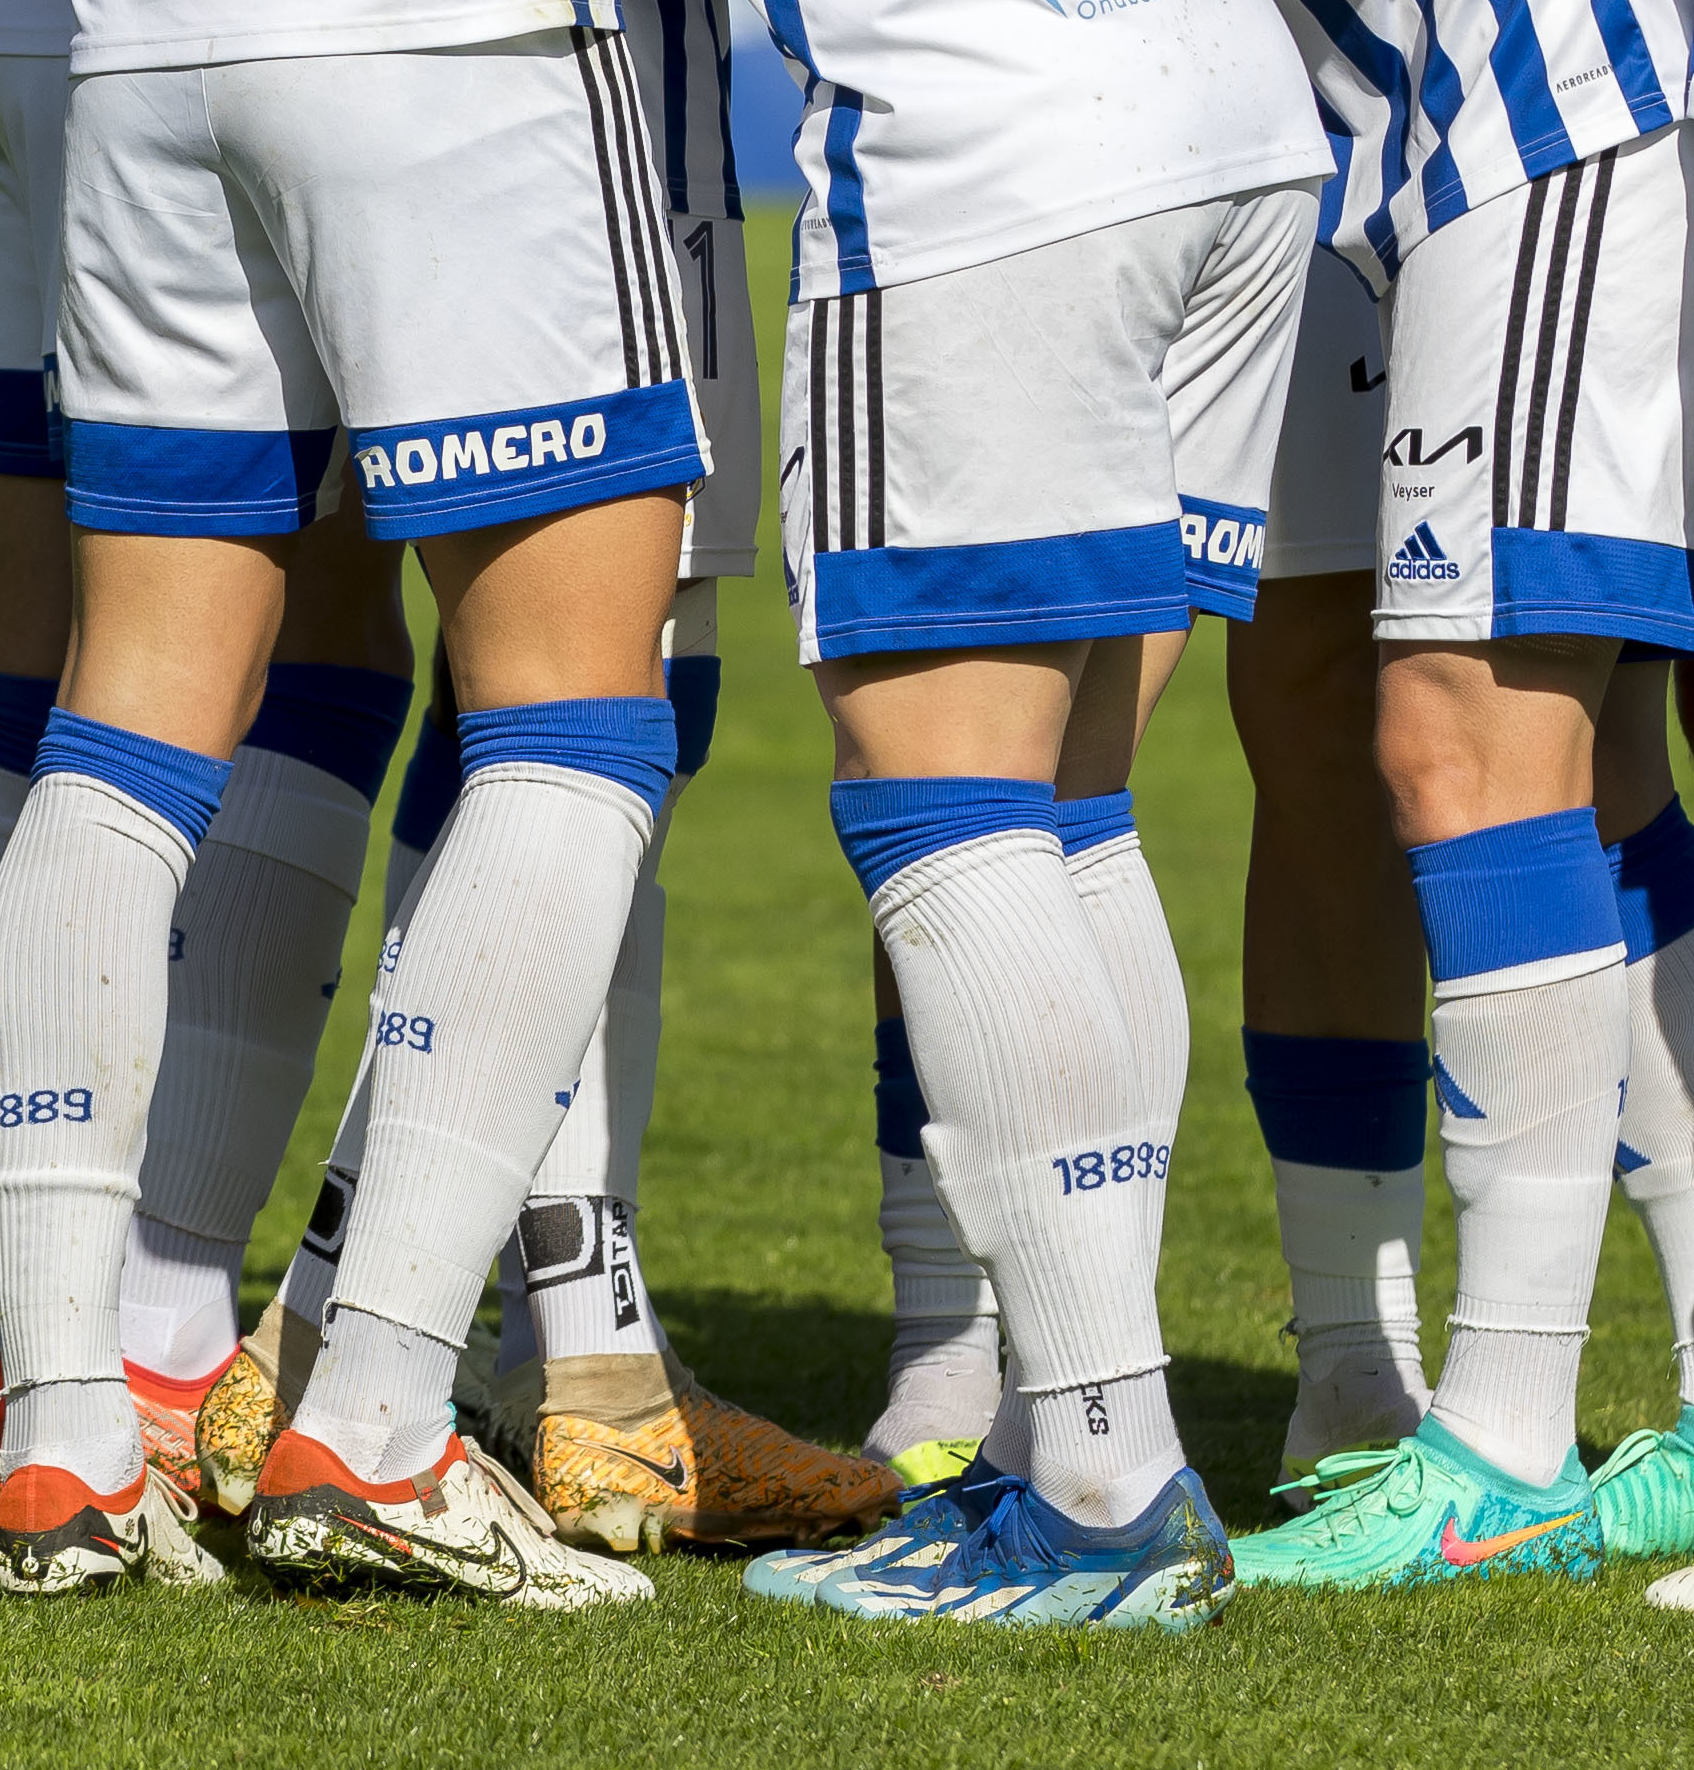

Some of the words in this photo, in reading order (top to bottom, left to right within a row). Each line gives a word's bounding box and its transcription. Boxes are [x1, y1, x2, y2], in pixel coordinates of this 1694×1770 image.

[355, 413, 607, 489] ROMERO
[1392, 483, 1435, 502] Veyser
[1179, 513, 1266, 570] ROM
[1389, 559, 1461, 580] adidas
